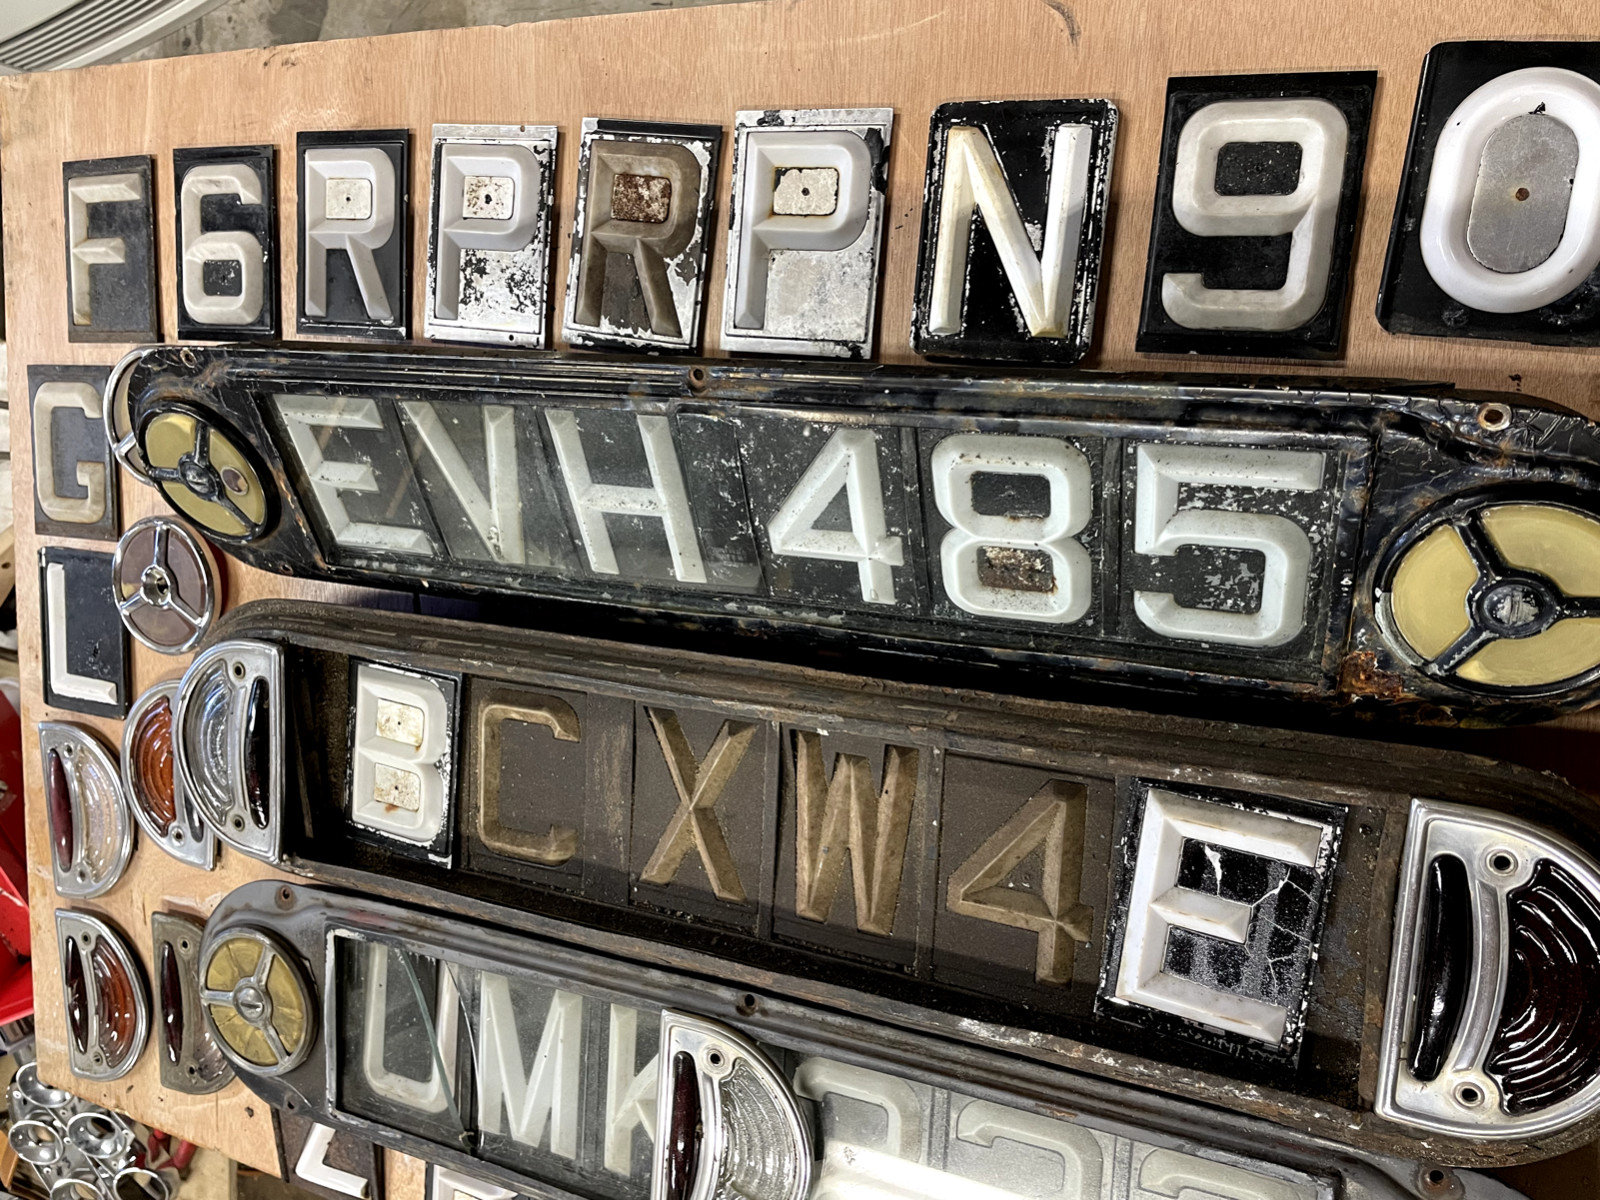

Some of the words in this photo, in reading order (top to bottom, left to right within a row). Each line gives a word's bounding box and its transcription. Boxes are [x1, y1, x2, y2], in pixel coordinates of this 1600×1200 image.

[67, 172, 142, 327] F
[180, 163, 265, 325] 6
[303, 147, 396, 321] R
[433, 143, 542, 321] P
[572, 141, 704, 338] R
[734, 130, 873, 331] P
[928, 123, 1093, 339] N
[1161, 98, 1351, 331] 9
[33, 381, 106, 524] G
[766, 427, 1327, 648] 485
[46, 562, 119, 706] L
